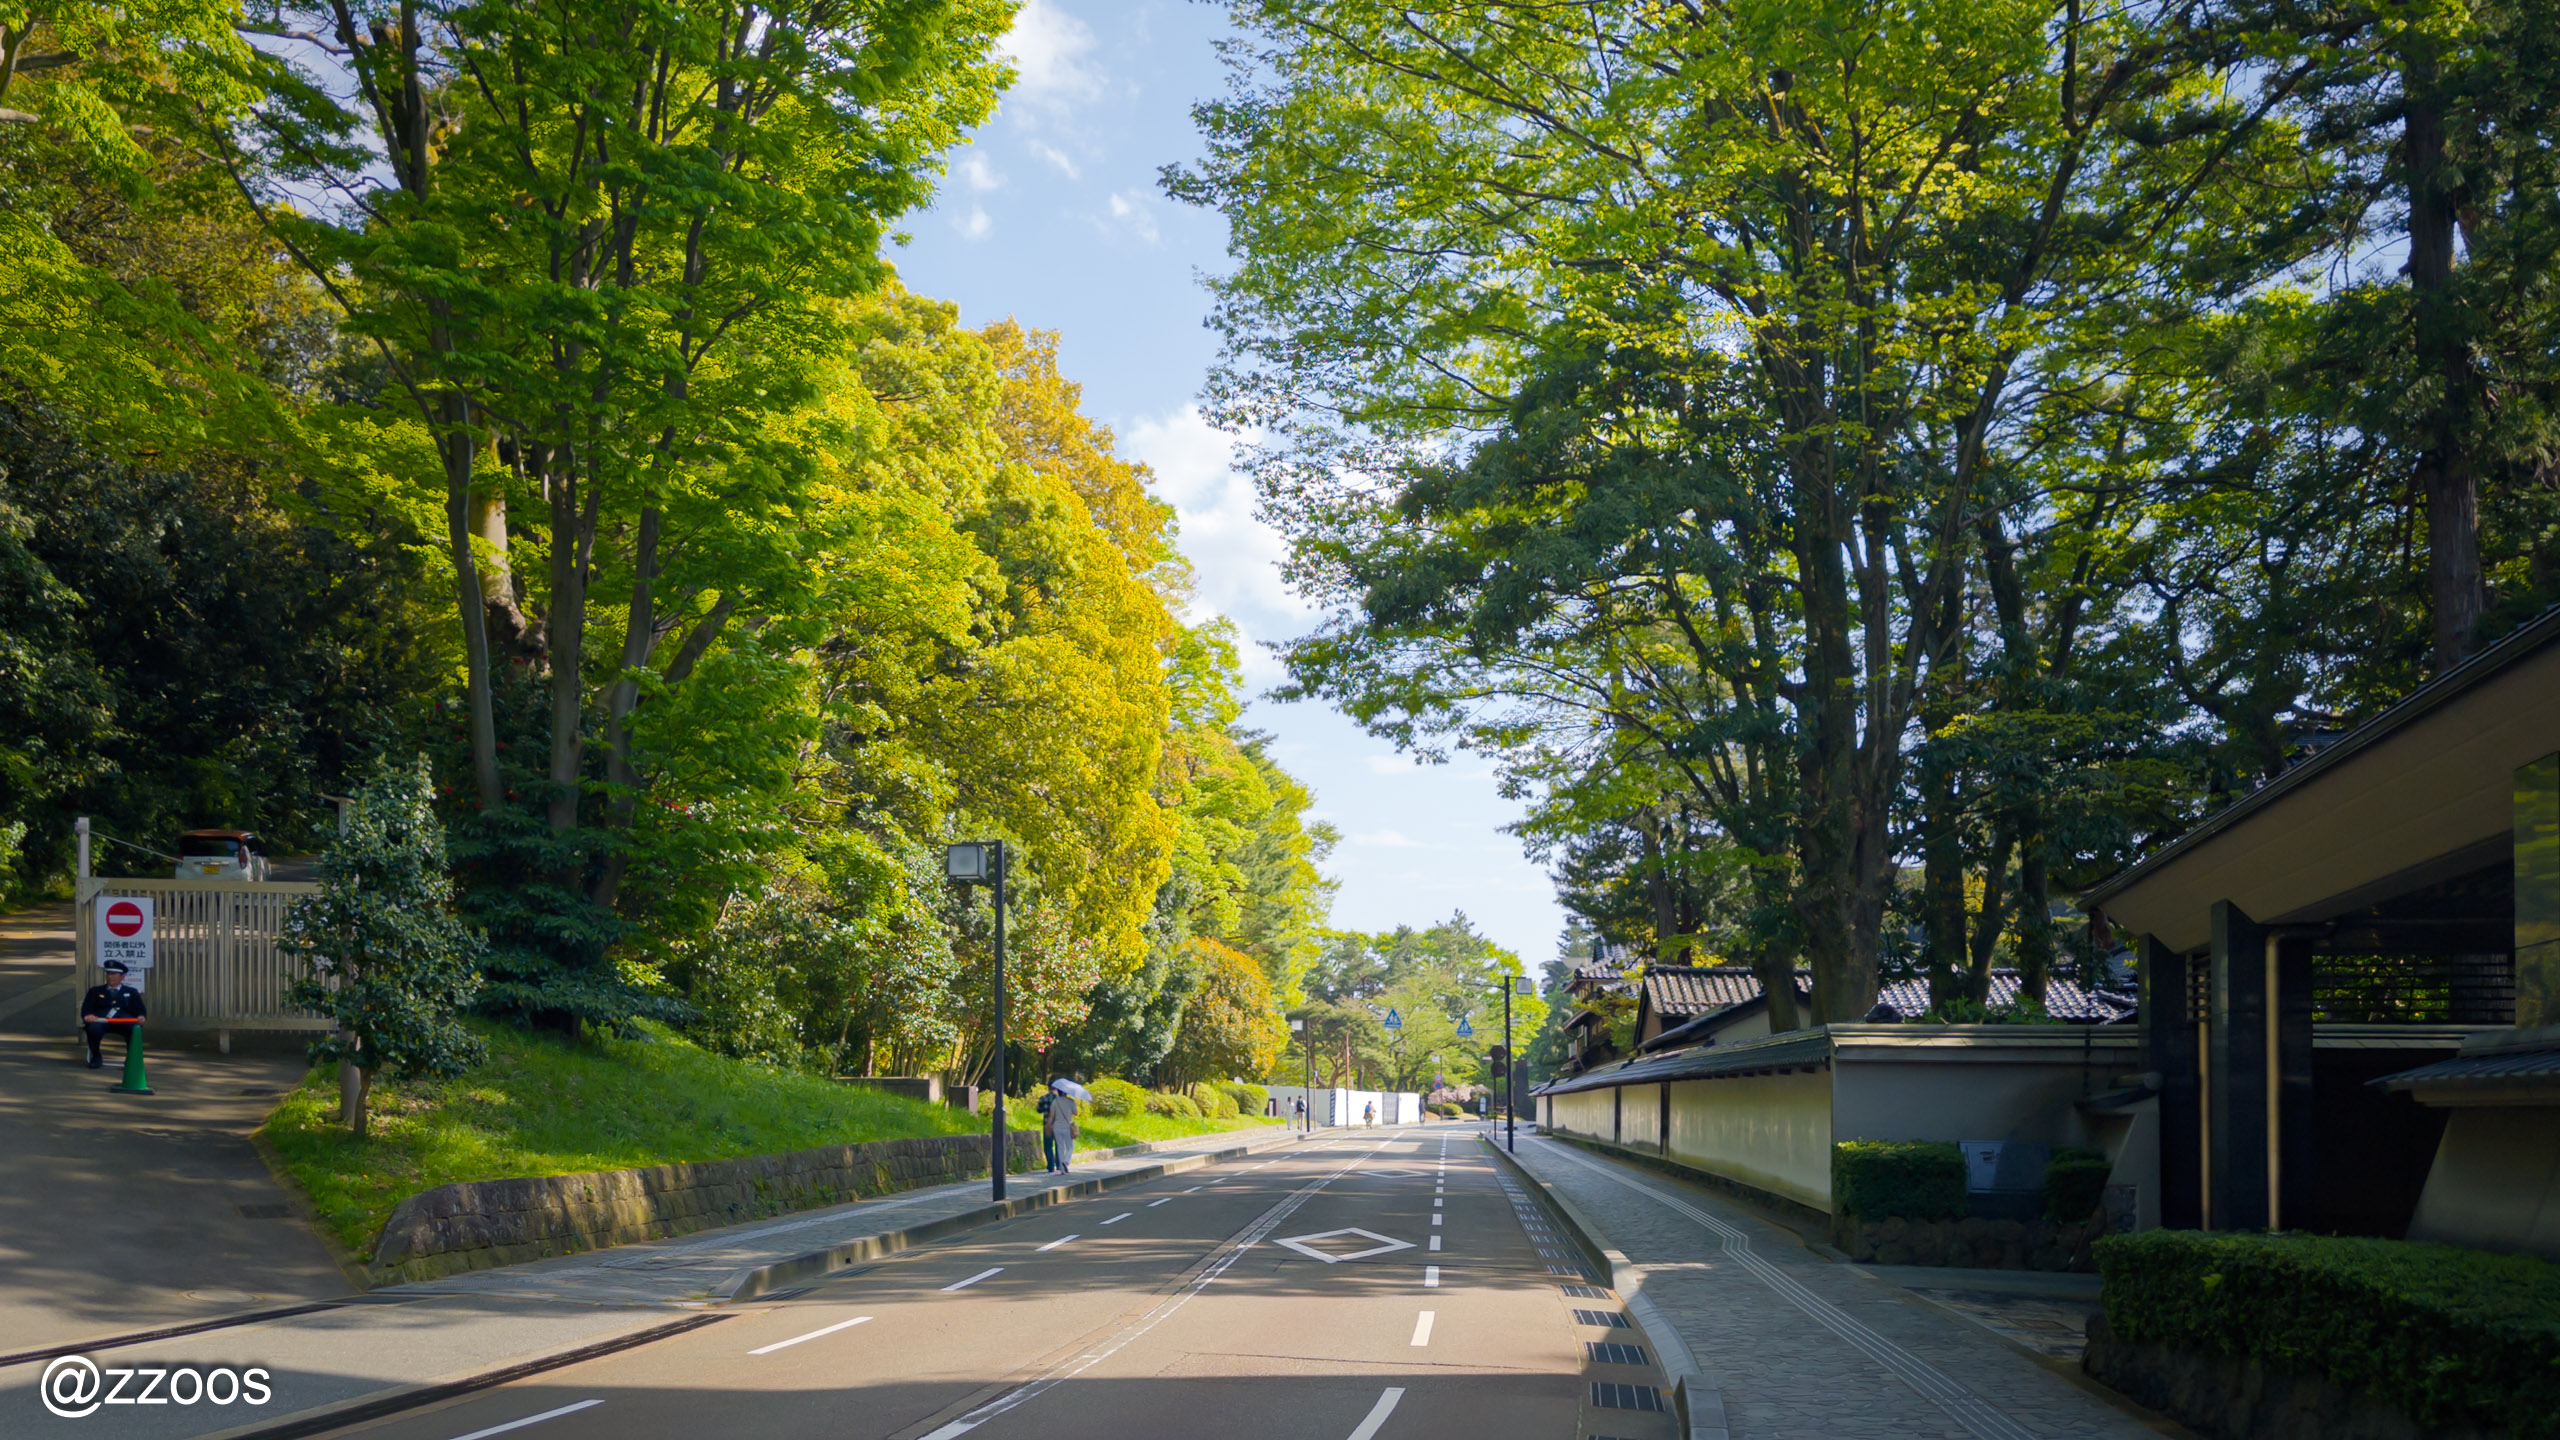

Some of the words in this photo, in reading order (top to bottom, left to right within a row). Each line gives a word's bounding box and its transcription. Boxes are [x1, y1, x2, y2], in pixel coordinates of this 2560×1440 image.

[104, 941, 146, 949] 関係者以外
[104, 950, 146, 958] 立入禁止
